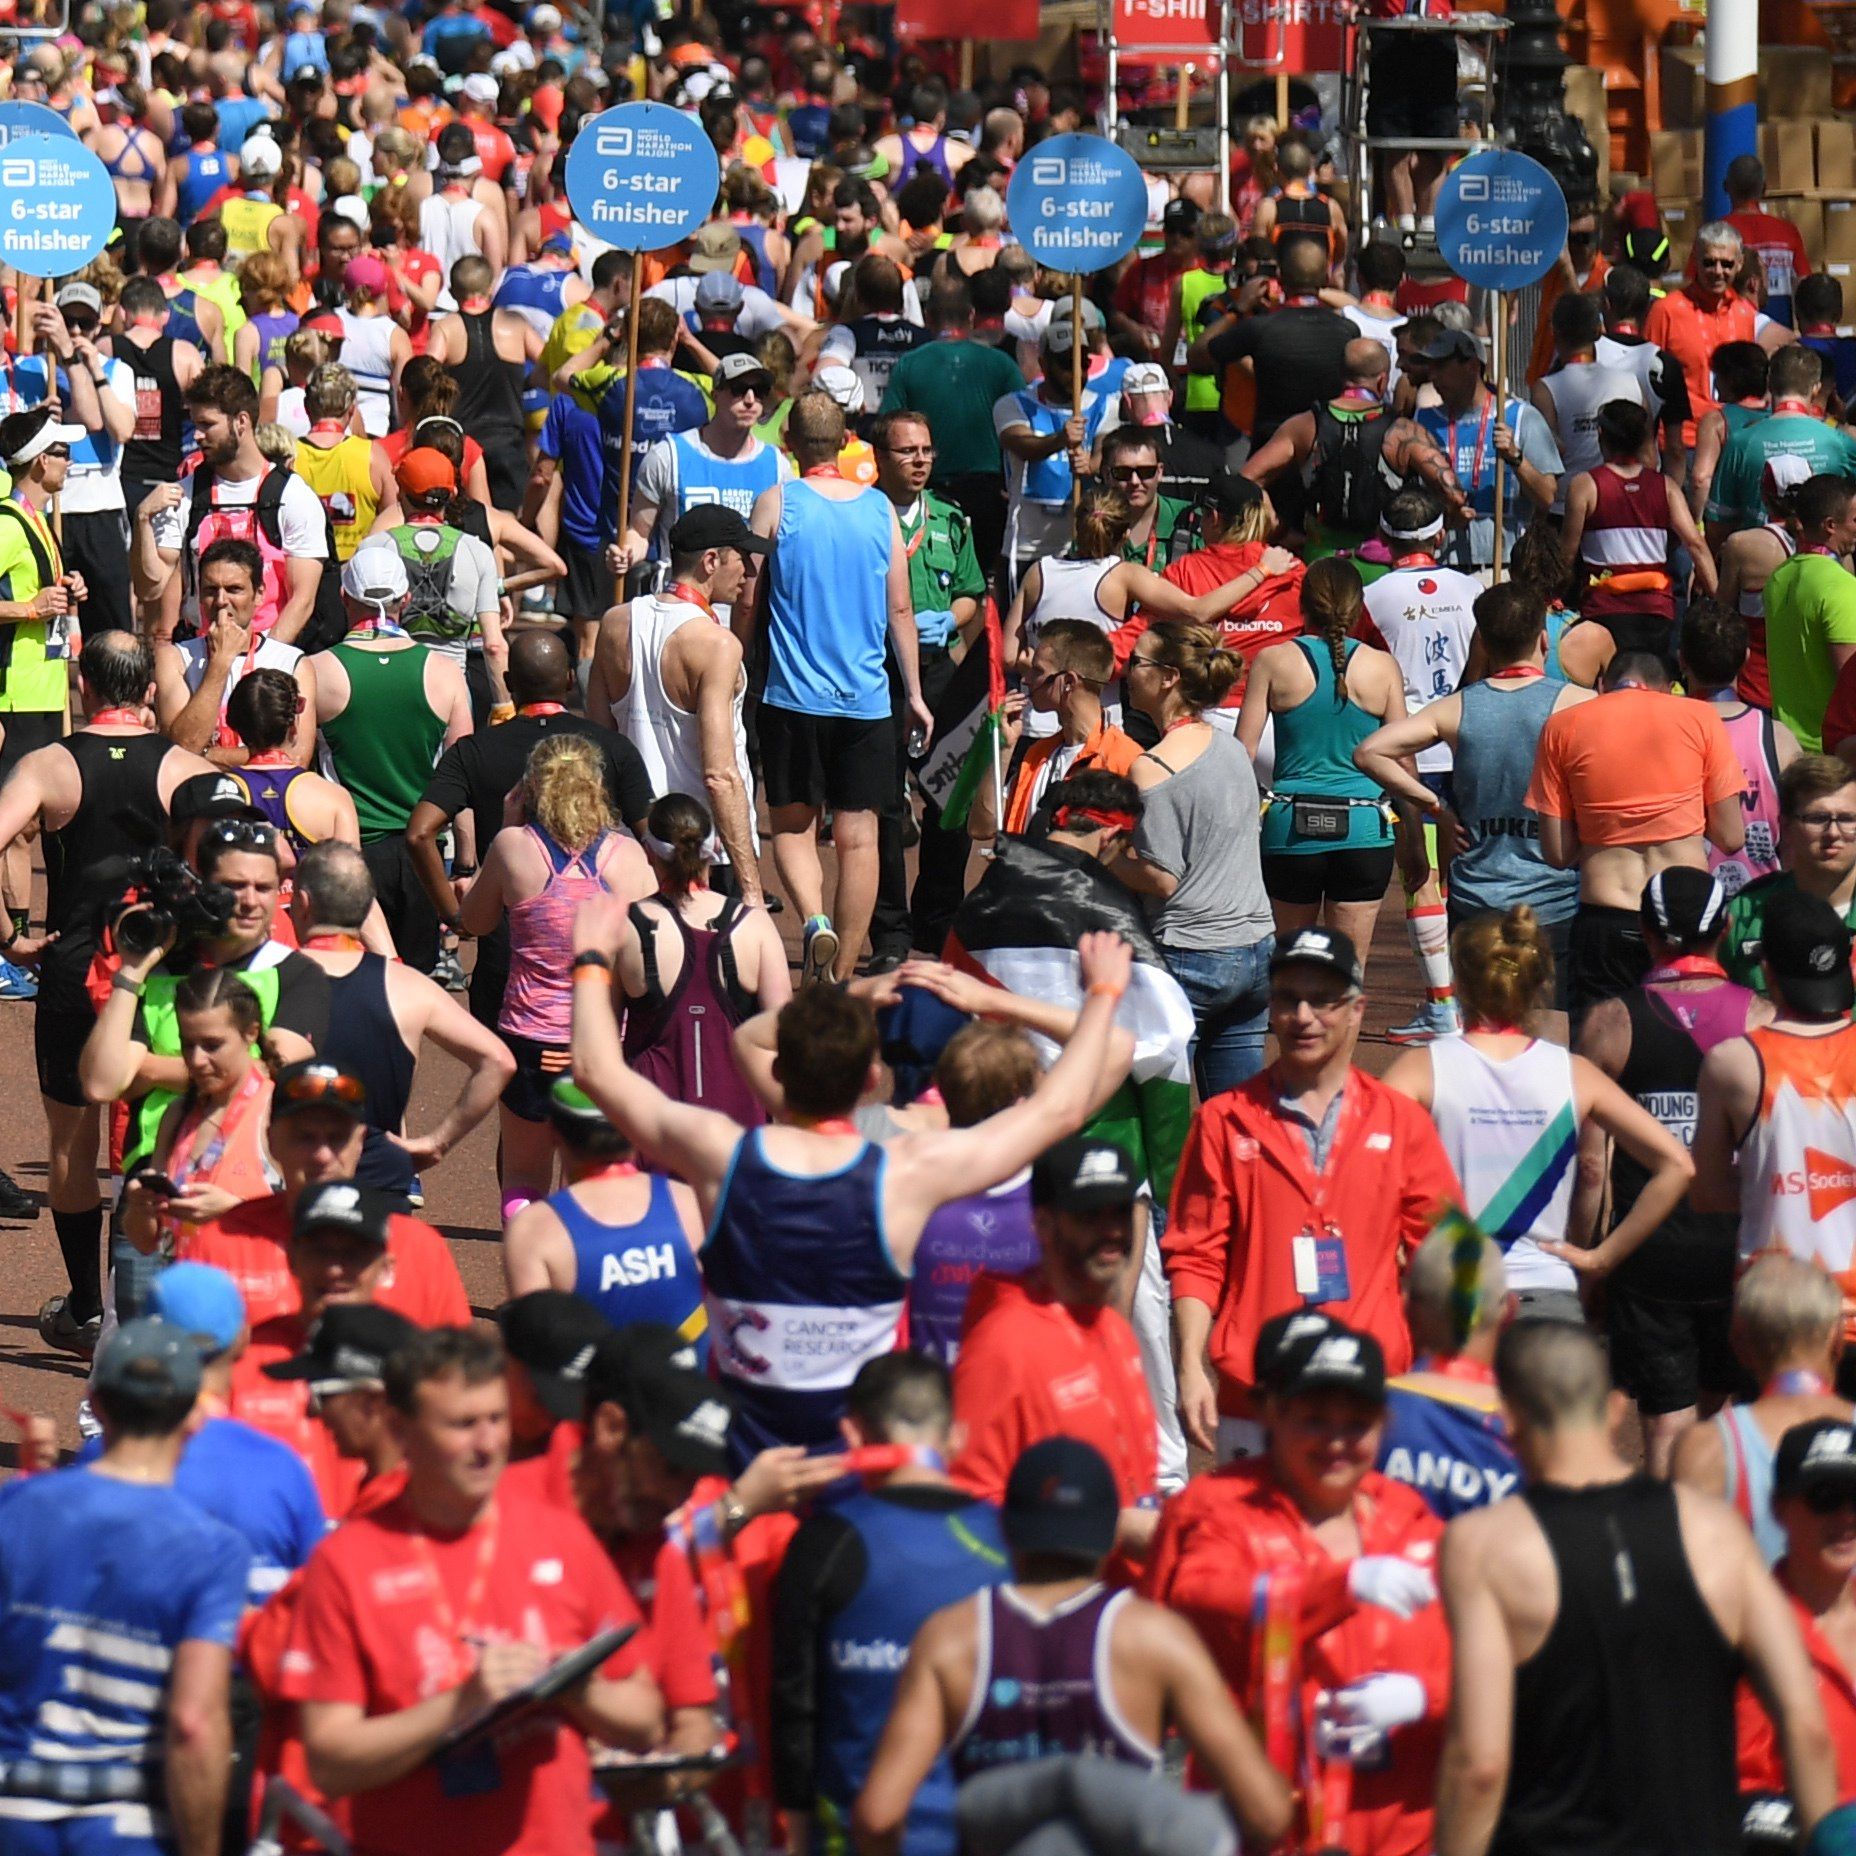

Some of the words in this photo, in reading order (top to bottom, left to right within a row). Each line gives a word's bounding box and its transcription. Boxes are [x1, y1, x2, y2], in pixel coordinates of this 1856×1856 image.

[1214, 0, 1346, 26] SHIRTS
[636, 134, 671, 142] WORLD
[636, 142, 692, 151] MARATHON
[636, 149, 676, 158] MAJORS
[602, 169, 681, 193] 6-star
[10, 198, 82, 220] 6-star
[591, 199, 689, 225] finisher
[1041, 197, 1114, 218] 6-star
[1466, 213, 1534, 236] 6-star
[3, 229, 91, 250] finisher
[1033, 226, 1123, 248] finisher
[1458, 244, 1543, 266] finisher
[1223, 619, 1283, 634] balance
[600, 1242, 677, 1291] ASH
[1385, 1446, 1517, 1504] ANDY
